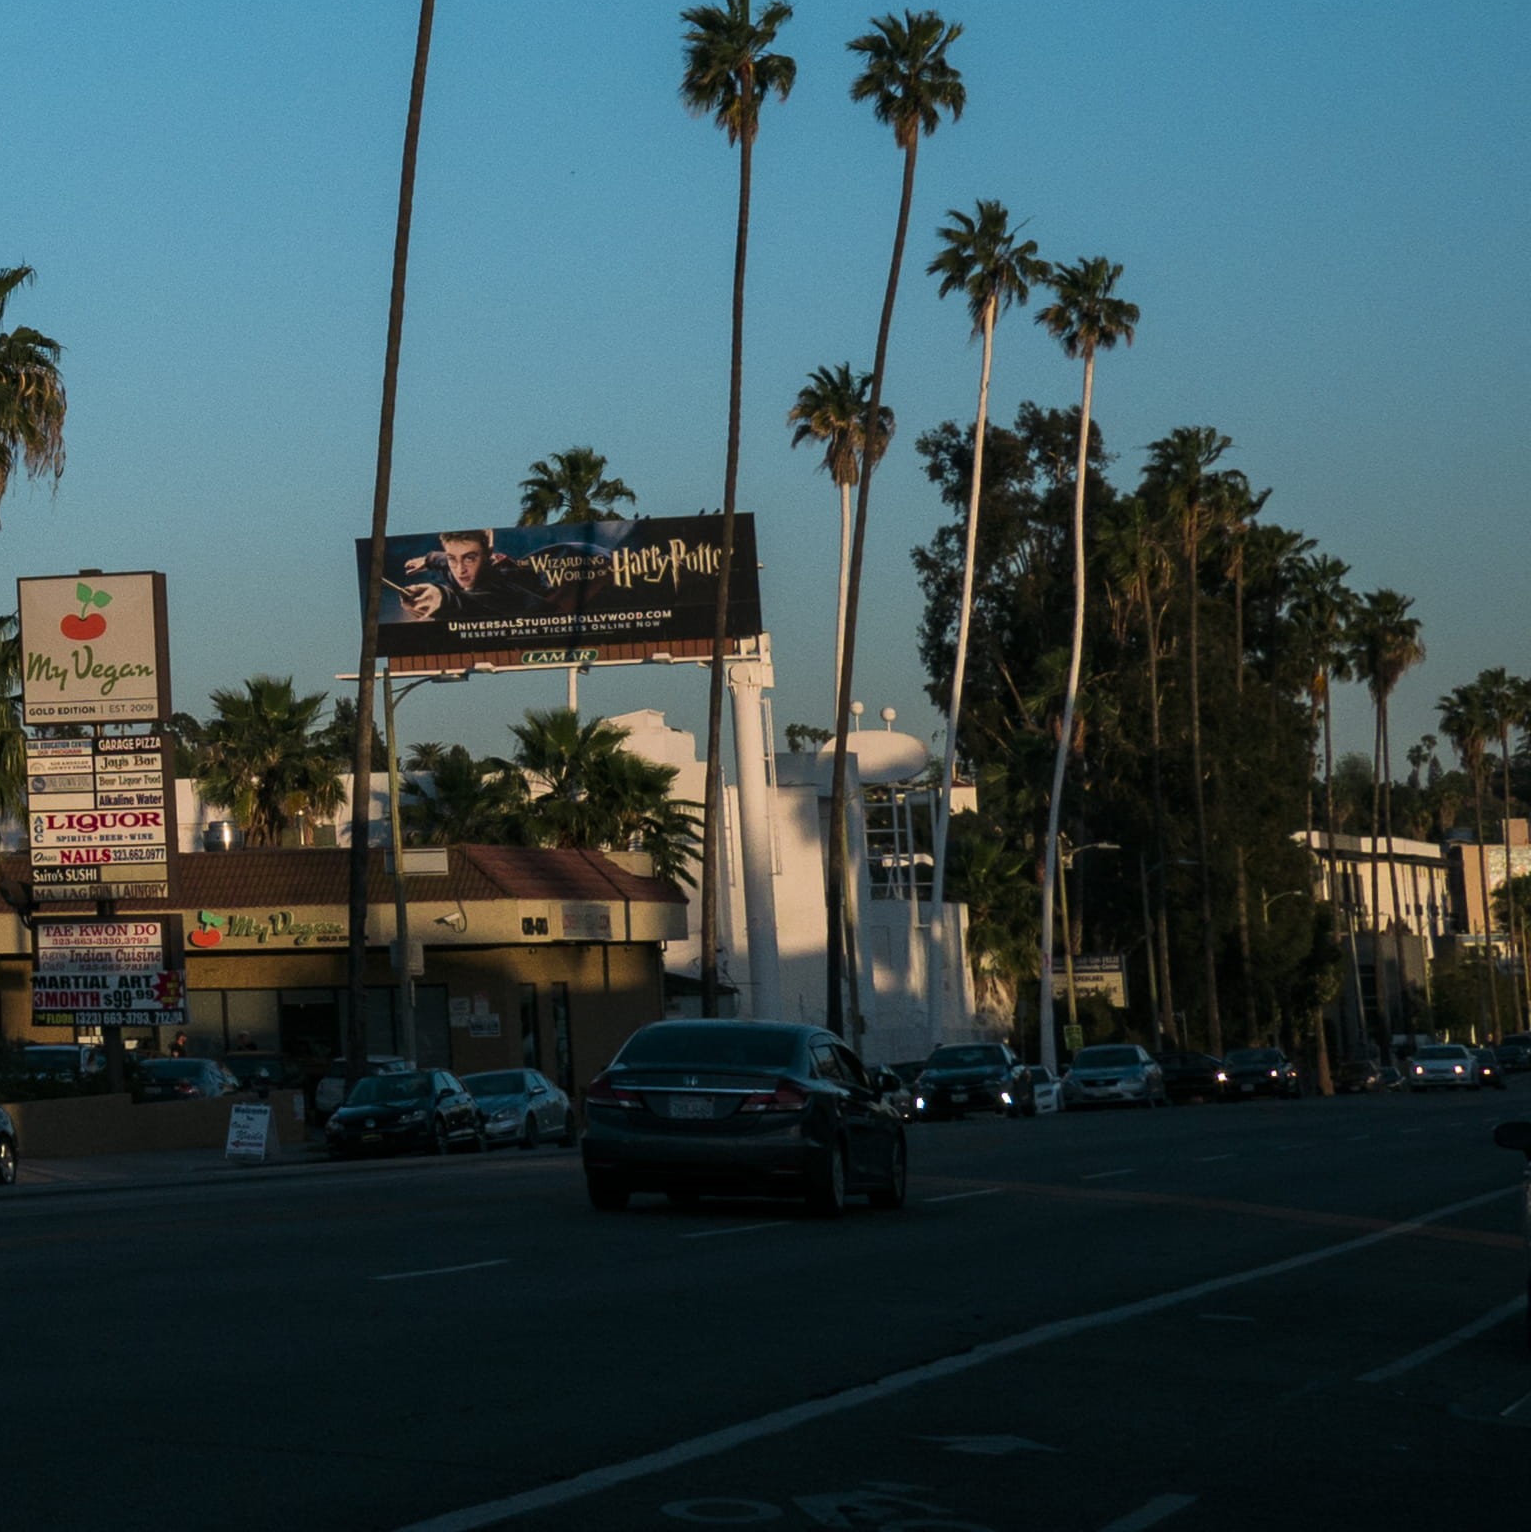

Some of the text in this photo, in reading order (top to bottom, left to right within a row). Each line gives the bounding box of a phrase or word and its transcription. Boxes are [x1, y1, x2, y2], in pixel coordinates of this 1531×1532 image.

[529, 553, 605, 575] WIZARDING
[607, 544, 670, 589] Harry
[666, 538, 735, 596] Potte
[546, 568, 608, 589] WORLD OF
[460, 619, 661, 639] RESERVE PARK TICKETS ONLINE NOW
[527, 650, 591, 663] LAMAR
[27, 645, 154, 696] My Vegan
[29, 703, 154, 716] GOLD EDITION EST. 2009
[99, 737, 161, 751] GARAGE PIZZA
[101, 754, 157, 770] Jay's Bar
[99, 793, 162, 807] Alkaline Water
[46, 811, 163, 834] LIQUOR
[56, 832, 154, 843] SPIRITS BEER WINE
[60, 848, 112, 864] NAILS
[65, 869, 98, 882] SUSHI
[43, 924, 157, 937] TAE KWON DO
[229, 911, 344, 946] My Vegan
[70, 949, 113, 963] Indian
[115, 948, 162, 962] Cuisine
[32, 974, 153, 990] MARTIAL ART
[33, 991, 101, 1008] 3MONTH
[104, 990, 155, 1009] $99.99
[75, 1011, 102, 1025] (323)
